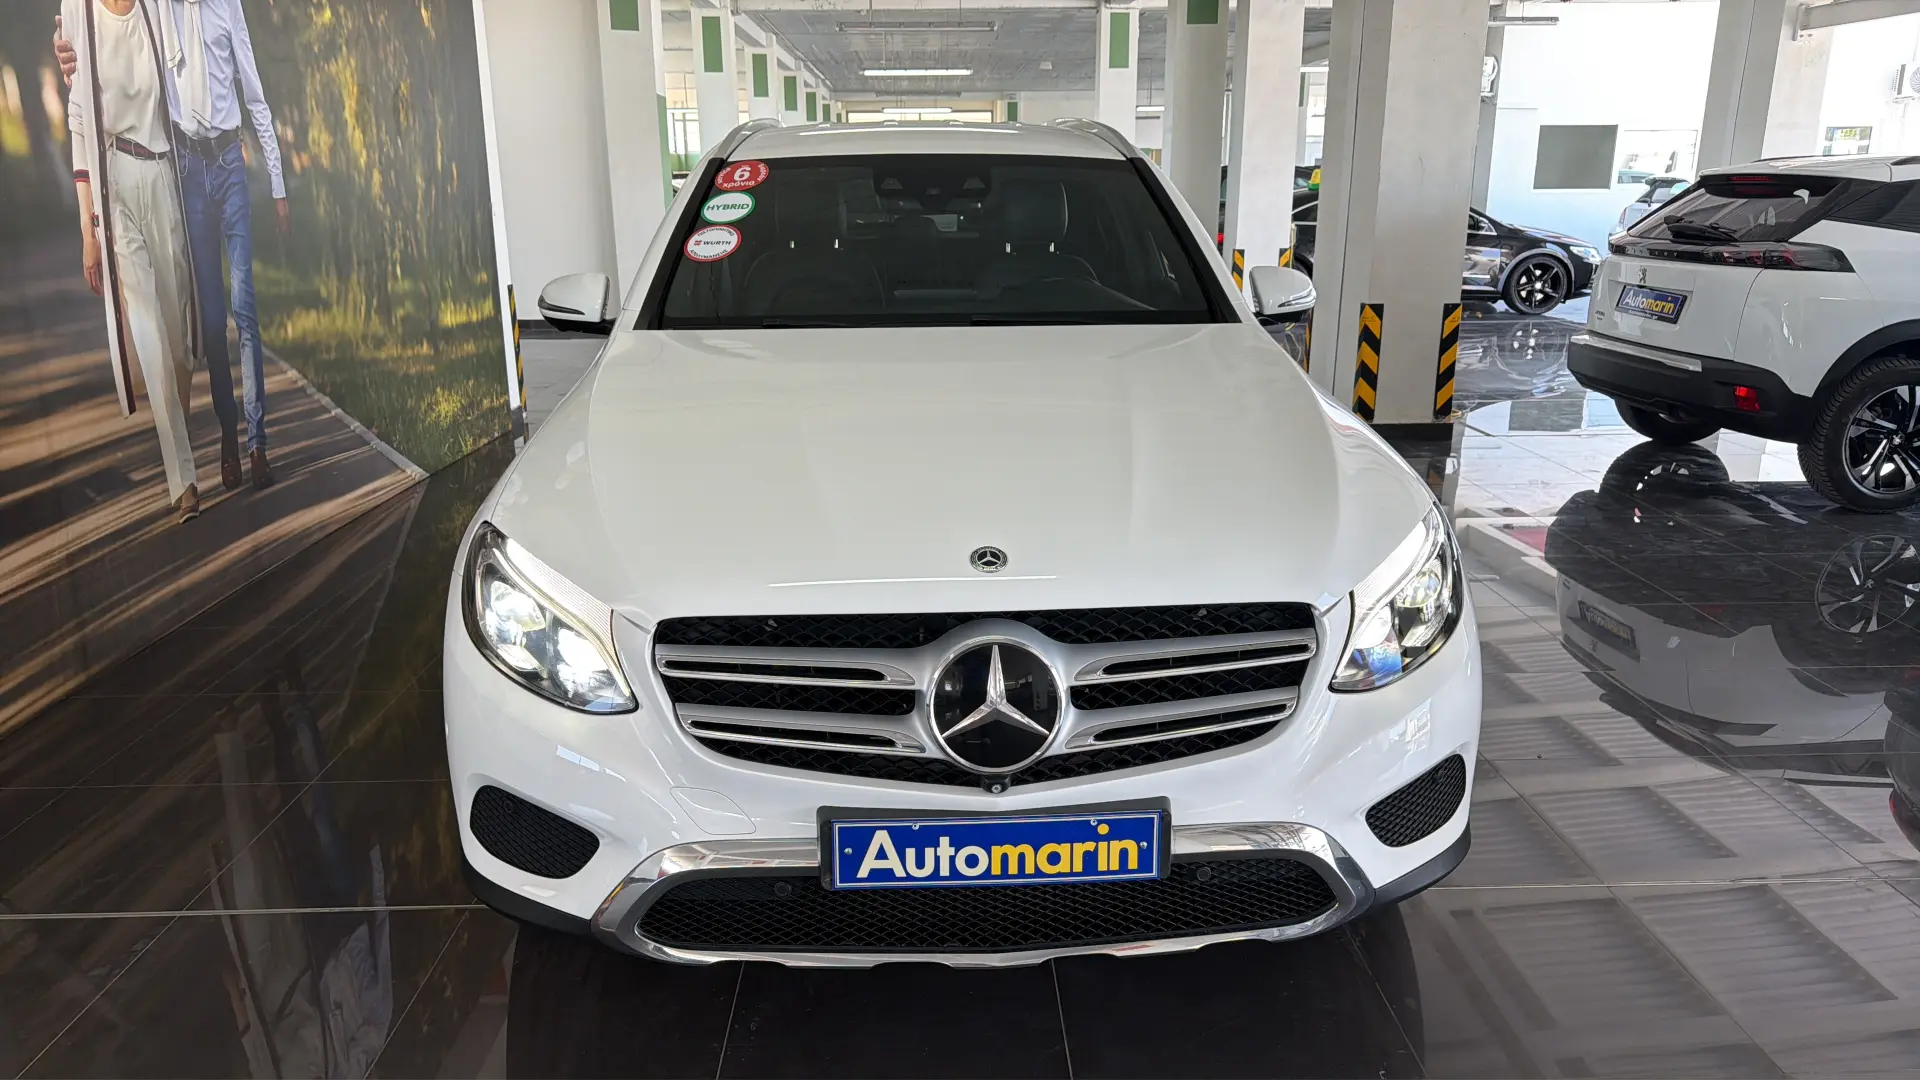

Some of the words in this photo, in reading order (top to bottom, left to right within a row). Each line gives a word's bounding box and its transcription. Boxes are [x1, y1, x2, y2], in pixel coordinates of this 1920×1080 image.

[733, 166, 751, 181] 6
[722, 180, 755, 188] χρόνια
[706, 203, 749, 211] HYBRID
[1622, 289, 1675, 315] Automarin
[856, 823, 1139, 879] Automarin
